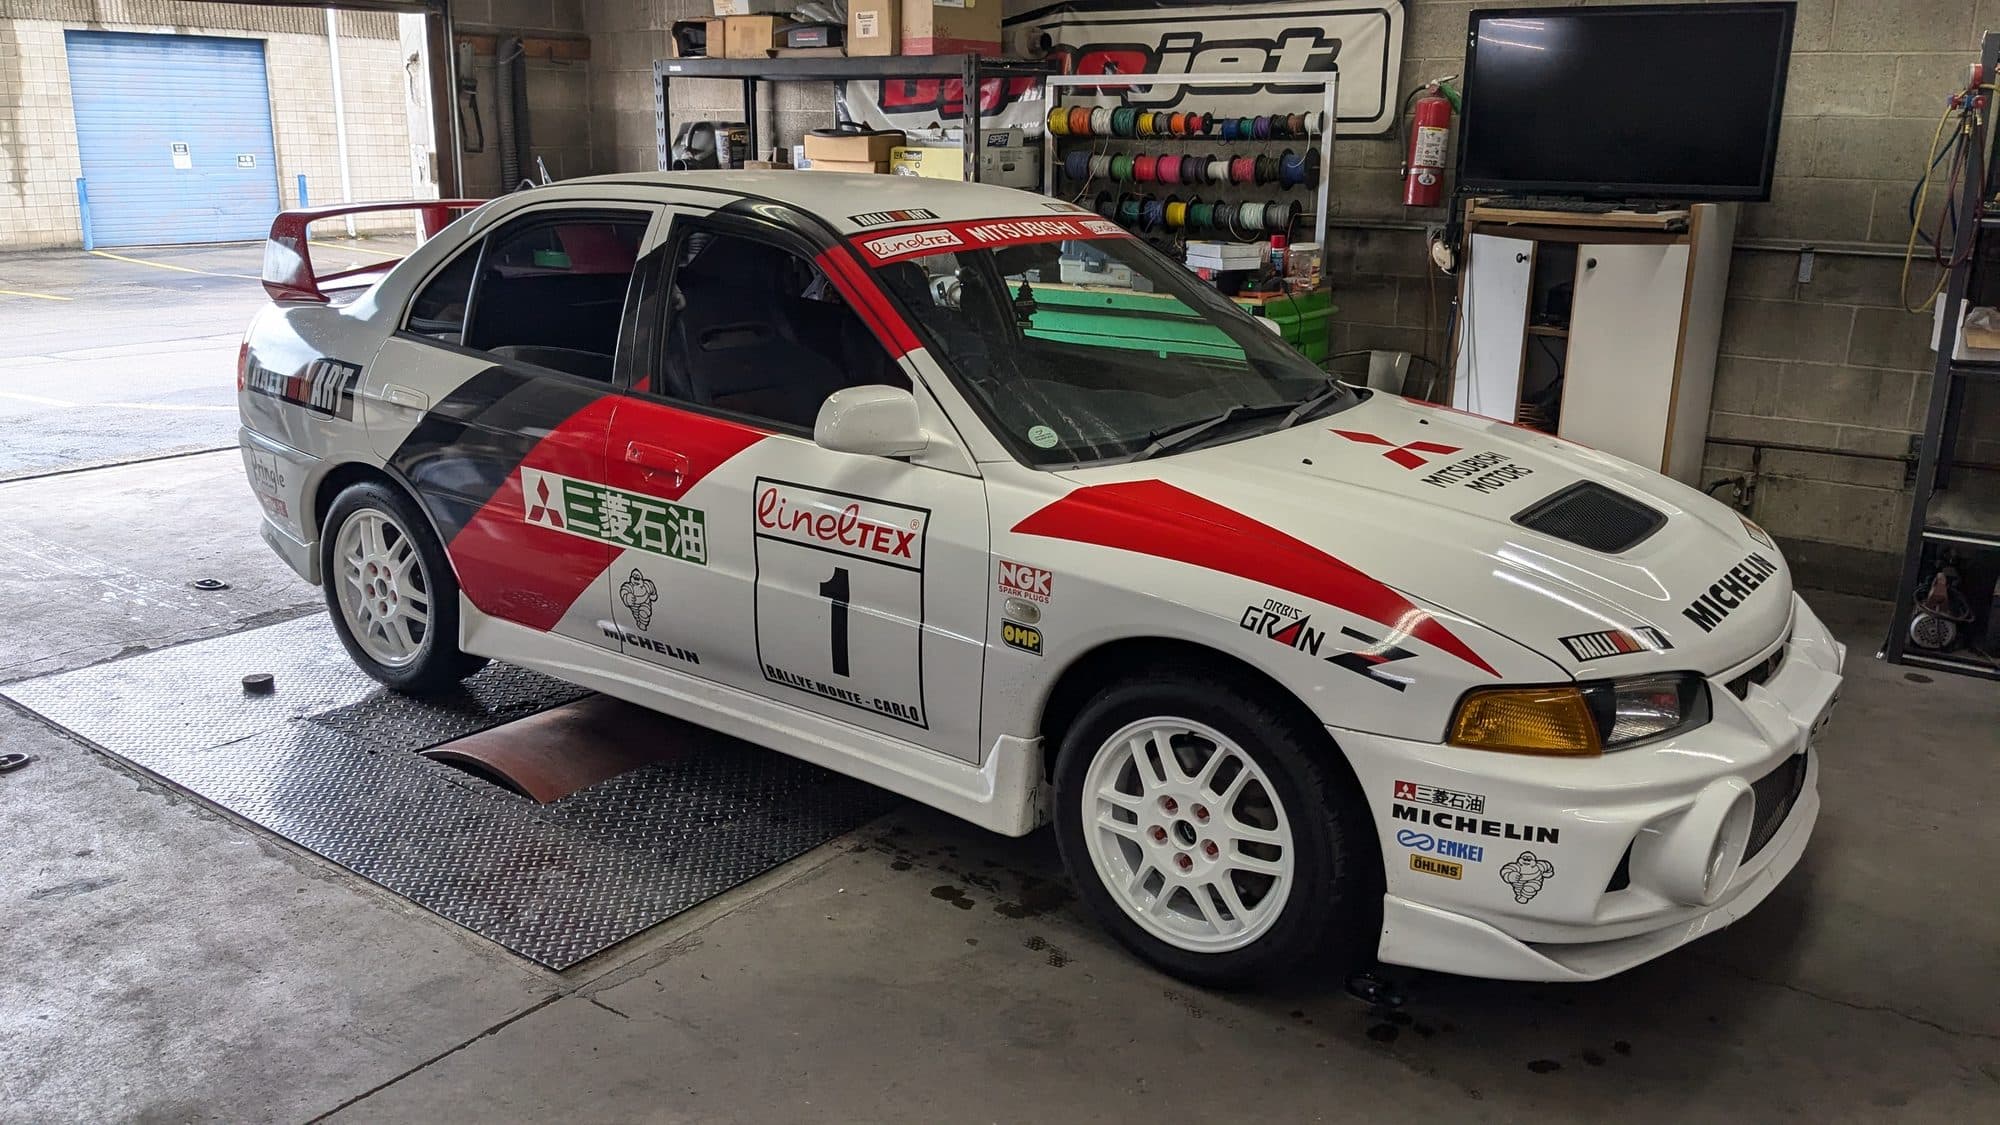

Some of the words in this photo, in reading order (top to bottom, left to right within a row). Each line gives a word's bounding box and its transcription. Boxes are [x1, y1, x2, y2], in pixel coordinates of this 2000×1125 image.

[965, 221, 1081, 243] MITSUBISHI
[1421, 451, 1511, 488] MITSUBISHI
[1464, 463, 1534, 494] MOTORS
[566, 486, 706, 563] 三菱石油
[998, 585, 1022, 598] SPARK
[1023, 589, 1050, 604] PLUGS
[999, 562, 1051, 596] NGK
[1681, 552, 1777, 634] MICHELIN
[819, 566, 850, 678] 1
[1263, 598, 1303, 620] ORBIS
[602, 628, 700, 665] MICHELIN
[1003, 625, 1040, 648] OMP
[765, 664, 817, 690] RALLYE
[815, 682, 862, 704] MONTE
[873, 698, 919, 722] CARLO
[1415, 786, 1483, 812] 三菱石油
[1392, 803, 1560, 844] MICHELIN
[1437, 838, 1483, 862] ENKEI
[1414, 857, 1459, 877] ÖHLINS
